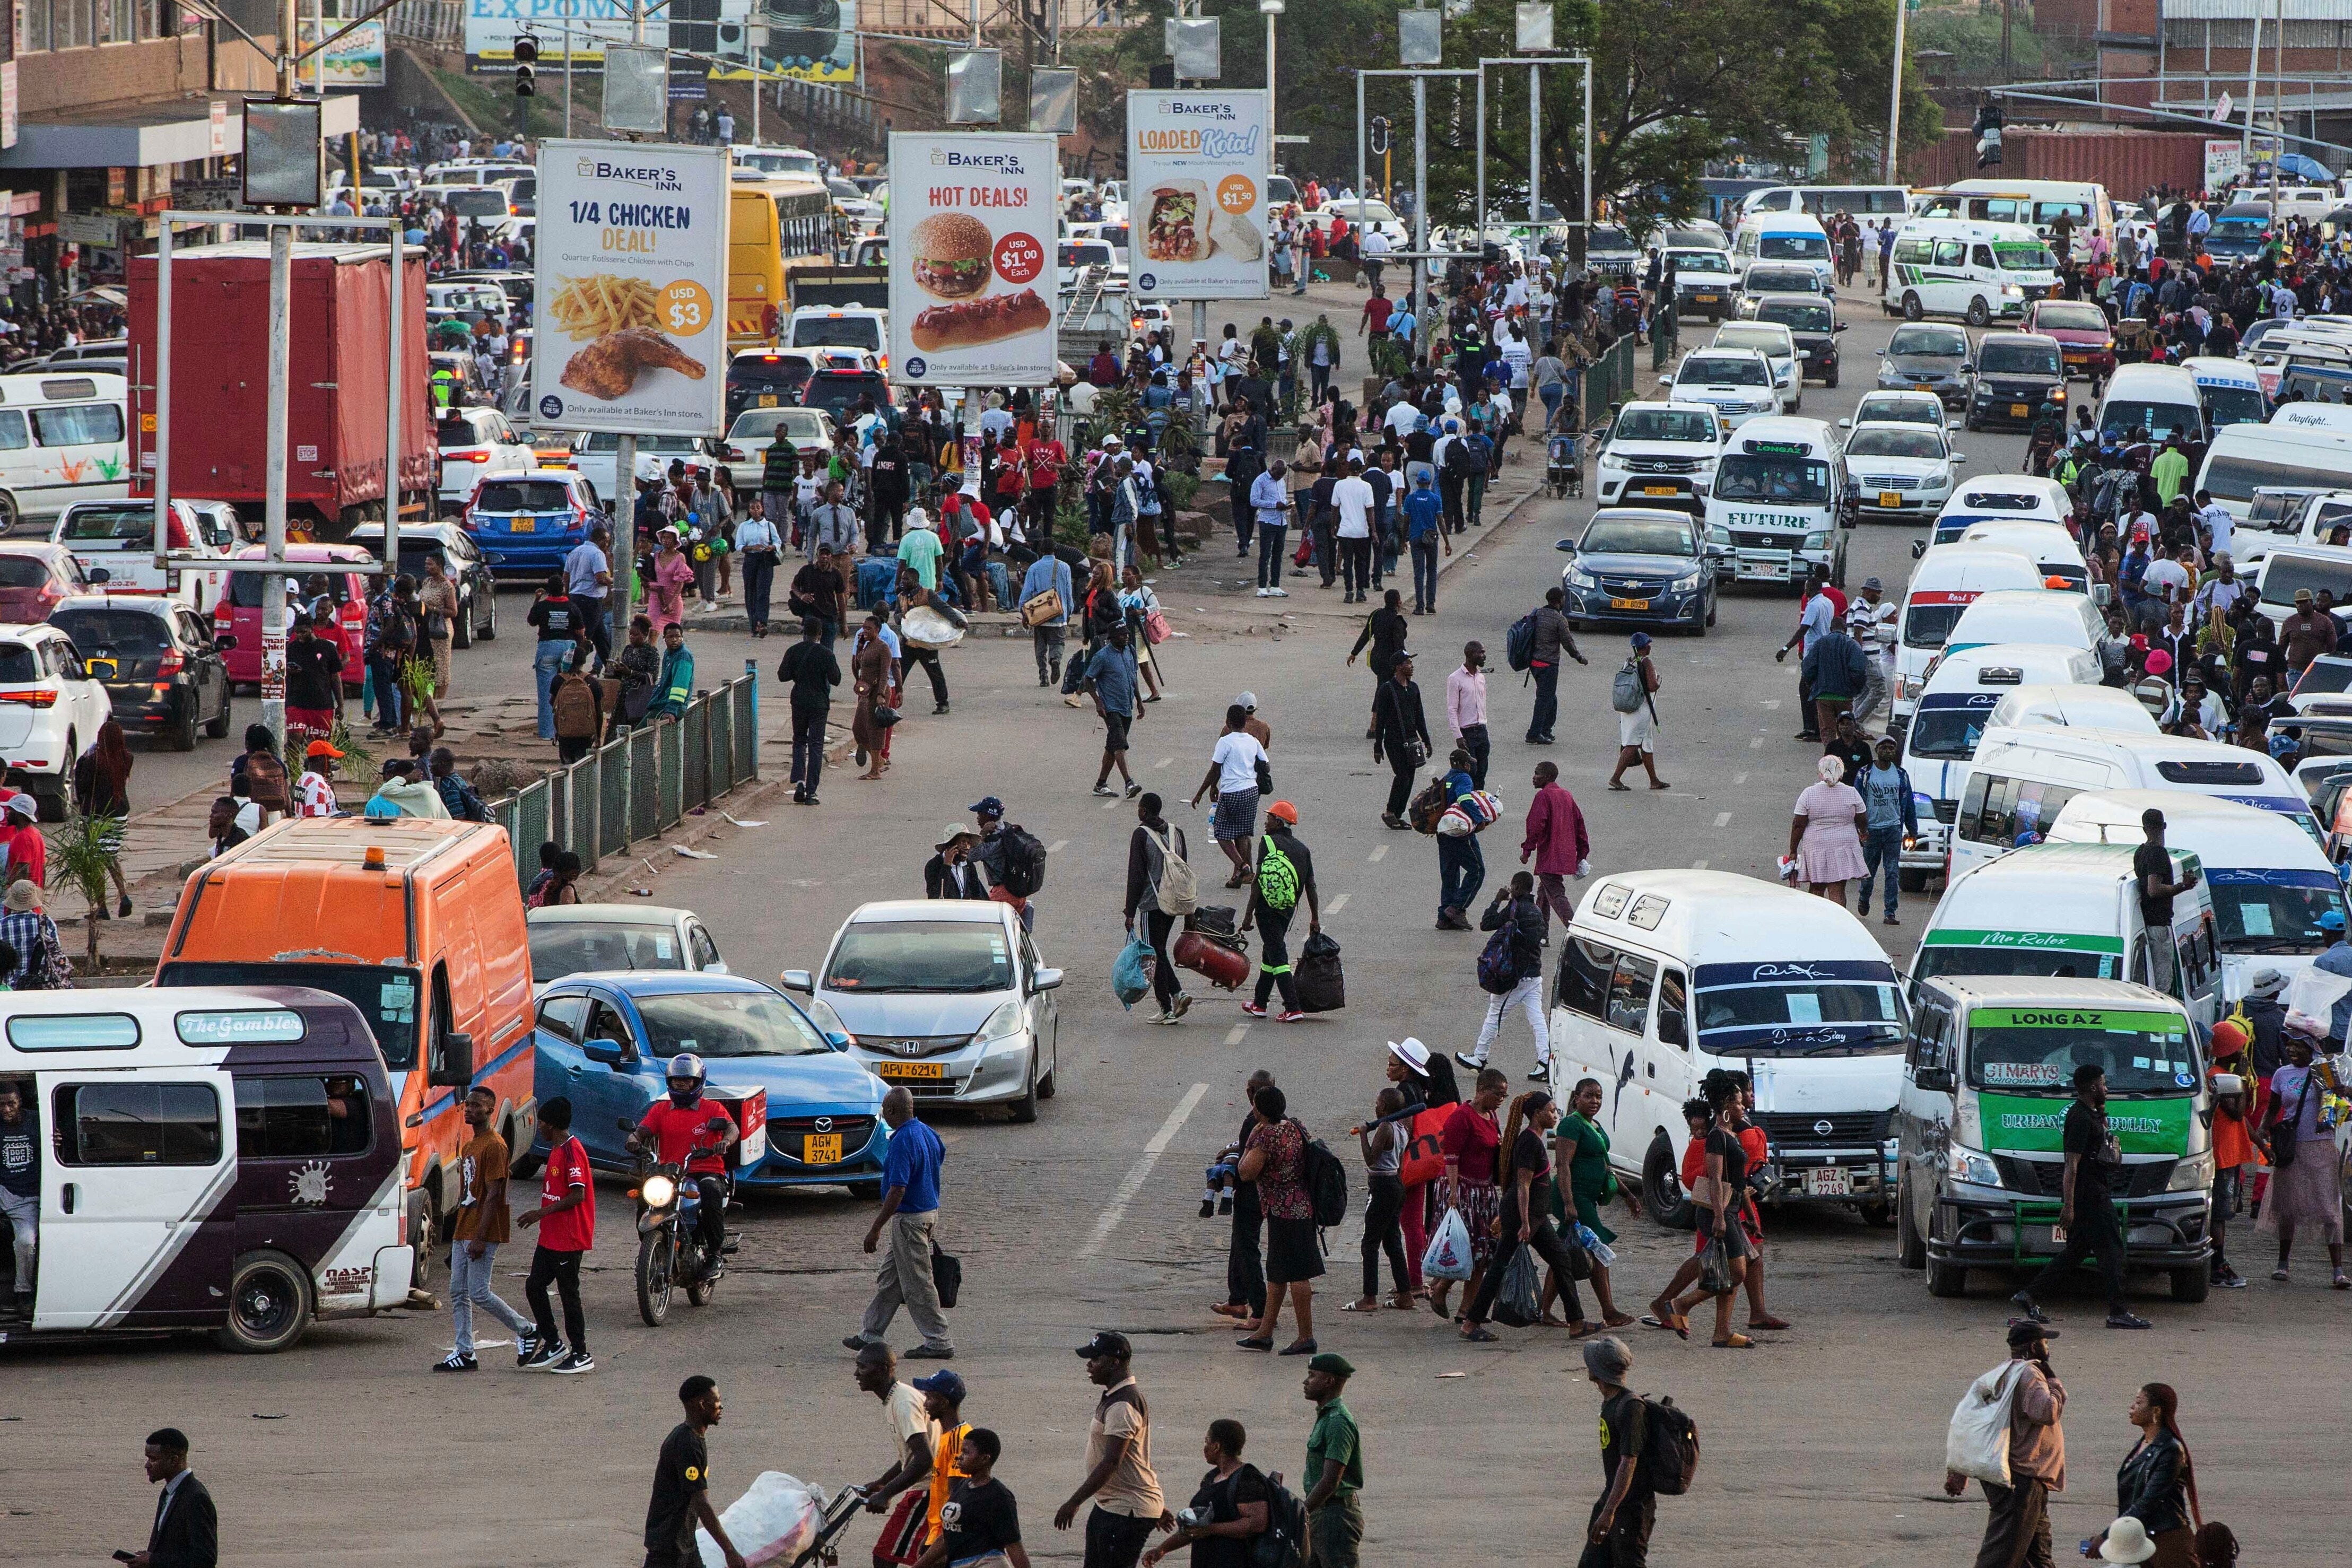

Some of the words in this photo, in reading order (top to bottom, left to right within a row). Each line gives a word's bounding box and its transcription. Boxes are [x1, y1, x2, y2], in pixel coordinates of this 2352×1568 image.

[1172, 102, 1231, 114] BAKER'S
[1138, 129, 1201, 150] LOADED
[1200, 124, 1259, 158] Kota!
[948, 152, 1019, 166] BAKER'S
[597, 162, 677, 181] BAKER'S
[655, 181, 682, 192] INN
[929, 186, 964, 207] HOT
[970, 187, 1028, 207] DEALS!
[1223, 192, 1252, 206] $1.50
[569, 201, 601, 224] 1/4
[609, 203, 690, 229] CHICKEN
[602, 229, 657, 253] DEAL!
[1009, 240, 1026, 249] USD
[562, 254, 590, 263] Quarter
[592, 255, 626, 264] Rotisserie
[628, 256, 656, 265] Chicken
[675, 259, 694, 268] Chips
[1001, 249, 1037, 269] $1.00
[1011, 267, 1030, 276] Each
[669, 288, 696, 300] USD
[669, 302, 701, 329] $3
[567, 404, 586, 413] Only
[588, 406, 622, 414] available
[633, 408, 663, 416] Baker's
[1756, 445, 1802, 454] LONGAZ
[1727, 512, 1811, 529] FUTURE
[1948, 593, 1967, 602] Real
[2016, 933, 2069, 946] Rolex
[2011, 1013, 2103, 1025] LONGAZ
[180, 1017, 217, 1033] The
[216, 1015, 303, 1038] Gambler
[883, 1064, 903, 1075] APV
[911, 1065, 937, 1076] 6214
[2001, 1113, 2060, 1129] URBAN
[2105, 1116, 2163, 1134] BULLY
[812, 1136, 832, 1148] AGW
[812, 1150, 837, 1162] 3741
[1816, 1169, 1837, 1182] AGZ
[1817, 1183, 1844, 1195] 2248
